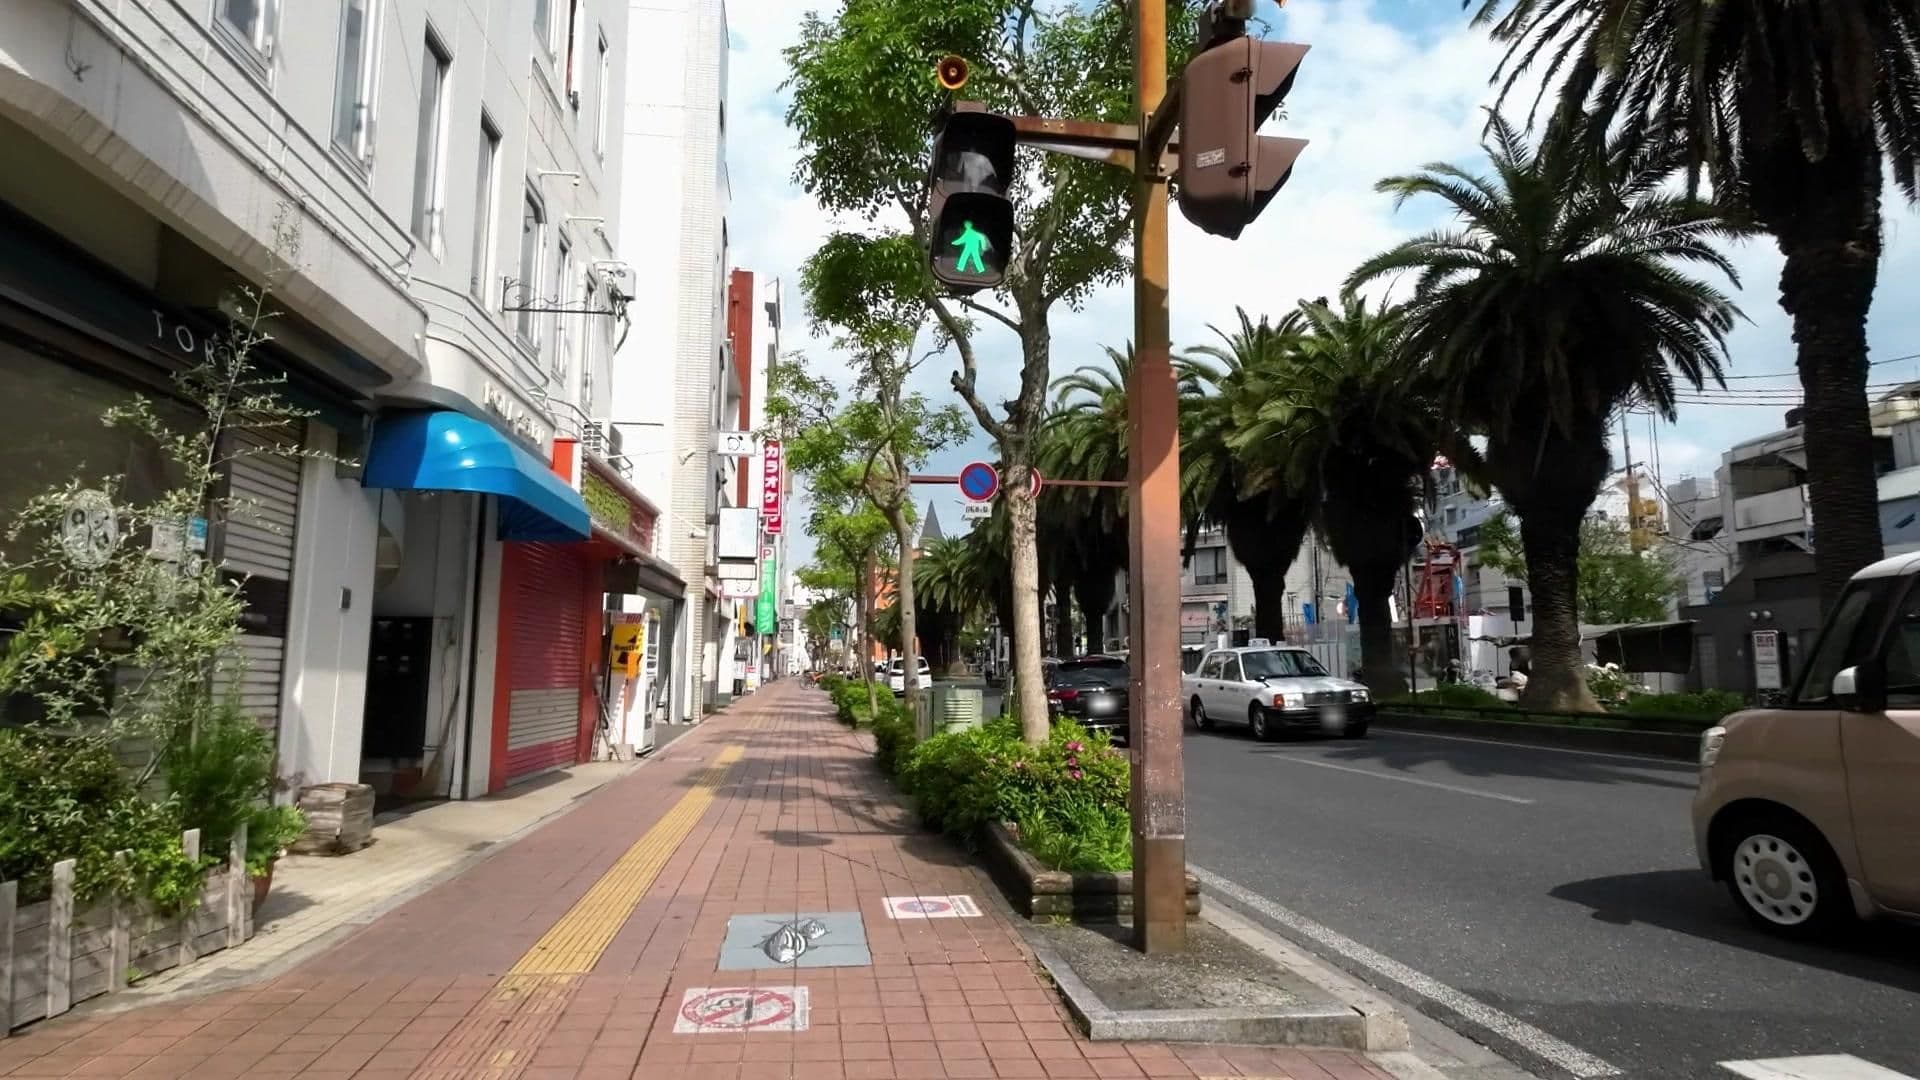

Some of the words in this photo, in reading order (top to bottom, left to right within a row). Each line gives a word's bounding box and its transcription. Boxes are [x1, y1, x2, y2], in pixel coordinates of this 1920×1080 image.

[765, 446, 779, 504] カラオケ
[763, 549, 771, 559] P
